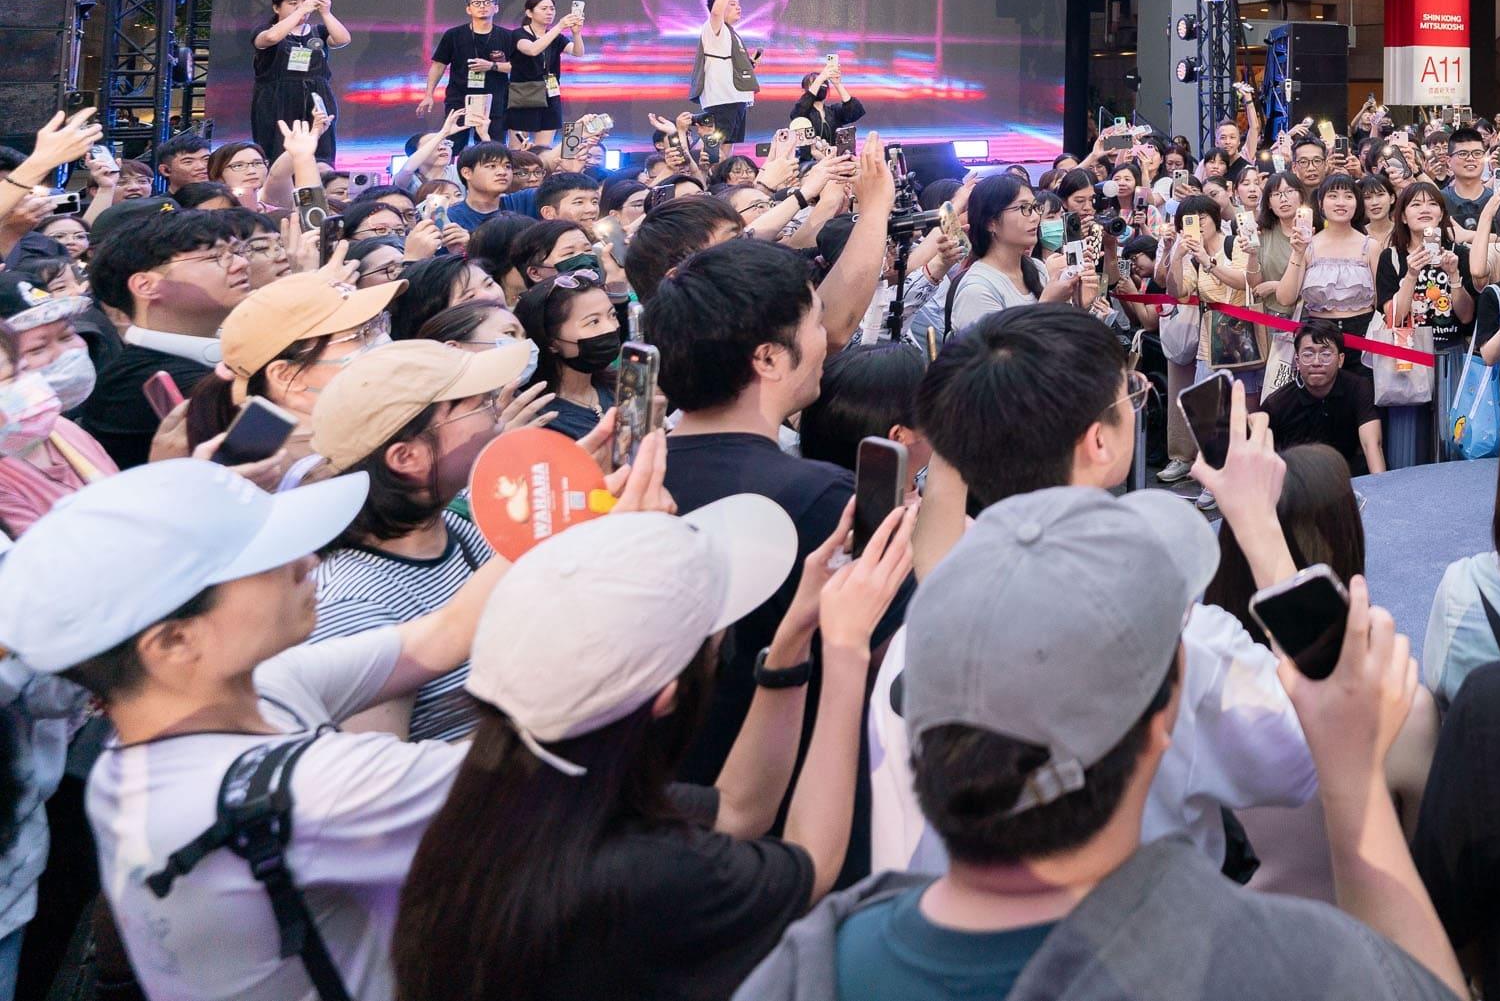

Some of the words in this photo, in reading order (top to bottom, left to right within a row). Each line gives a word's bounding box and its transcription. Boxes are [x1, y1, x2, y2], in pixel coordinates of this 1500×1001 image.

[1423, 13, 1440, 21] SHIN
[1420, 22, 1464, 31] MITSUKOSHI
[1421, 56, 1461, 83] A11
